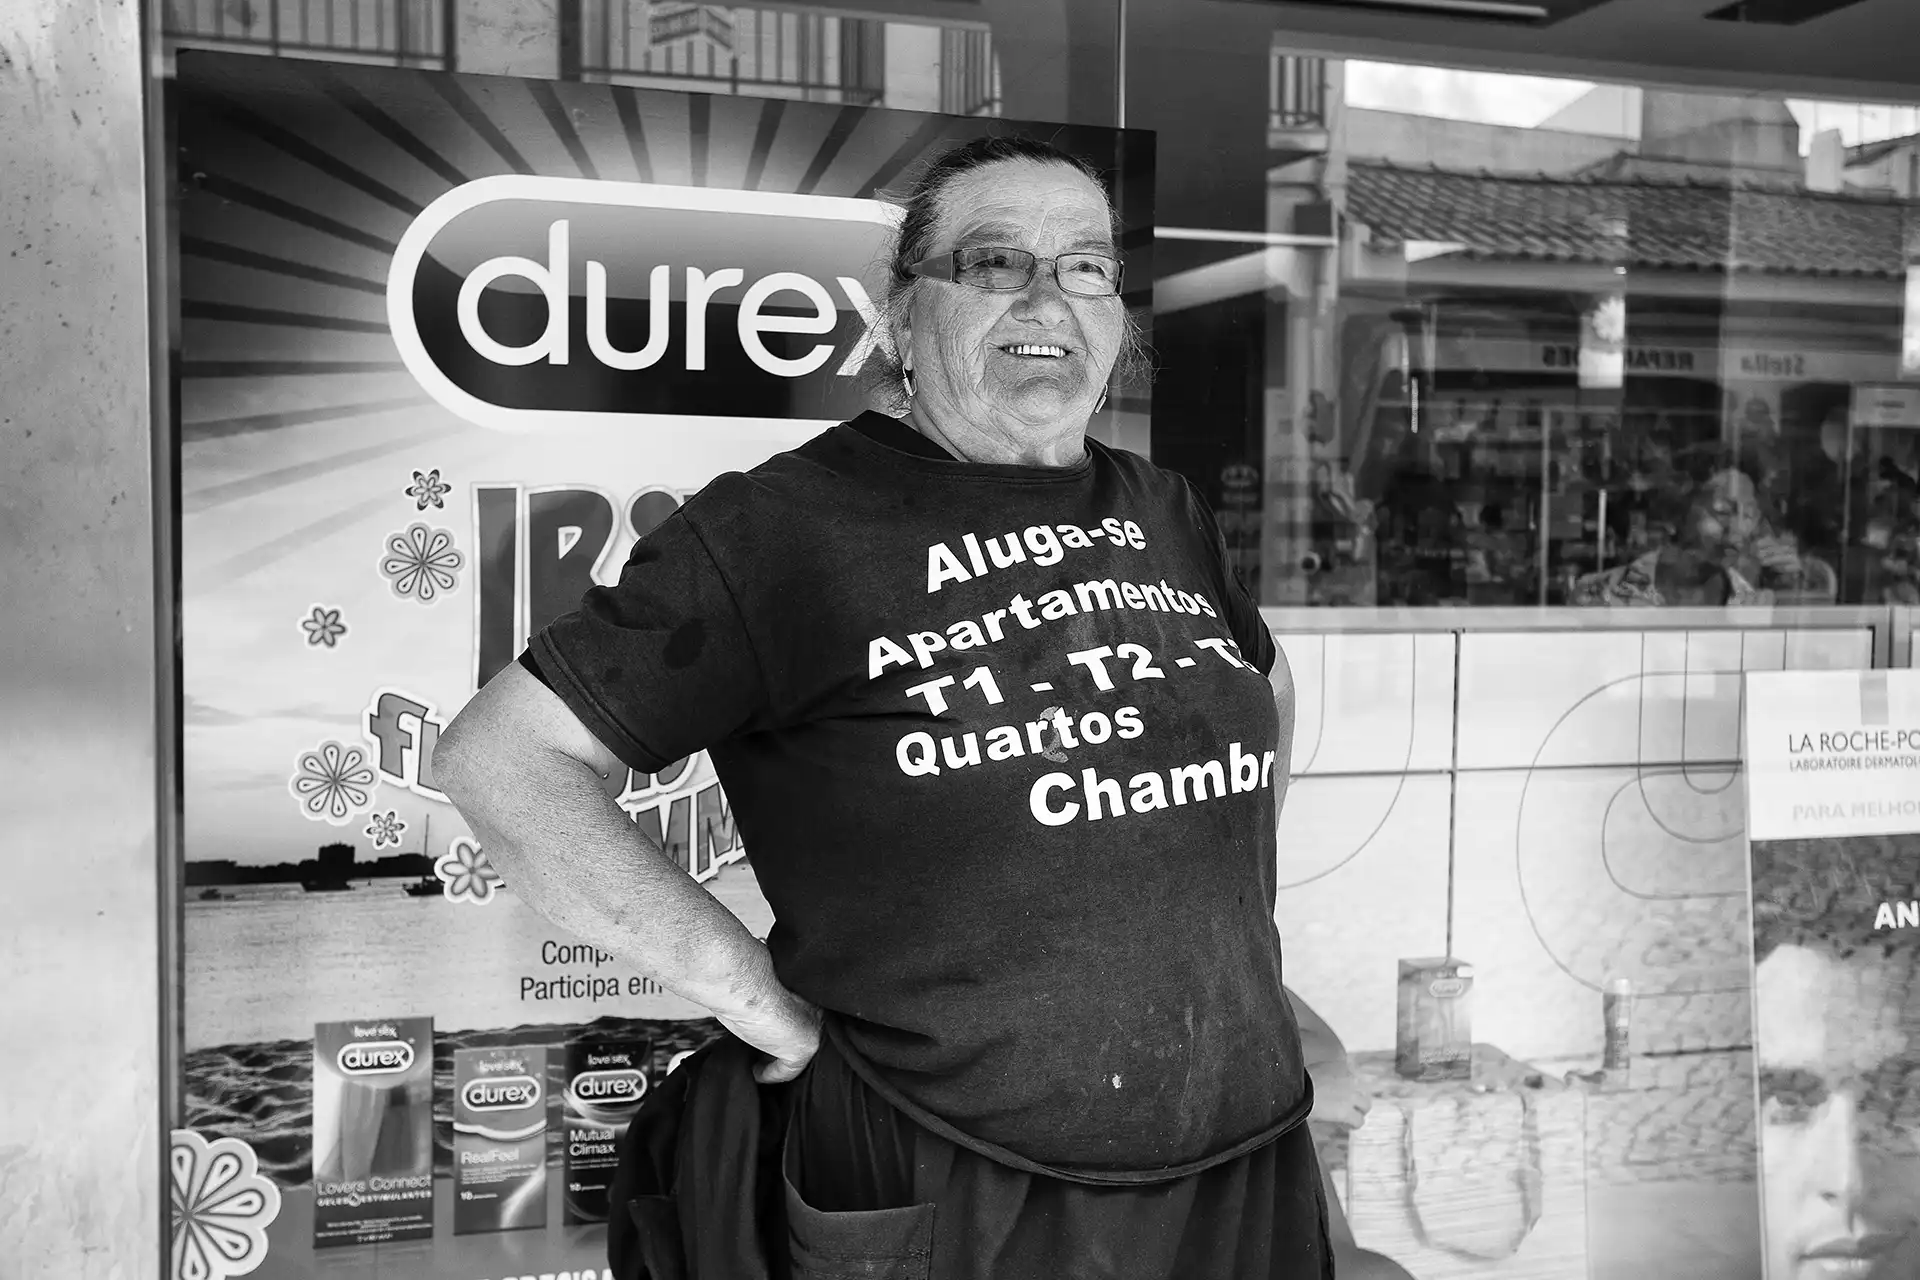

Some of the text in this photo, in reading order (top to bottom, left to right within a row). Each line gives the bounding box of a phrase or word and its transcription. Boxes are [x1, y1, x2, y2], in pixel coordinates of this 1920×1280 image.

[457, 218, 898, 377] durex
[927, 517, 1147, 594] Aluga-se
[868, 578, 1217, 680] Apartamentos
[905, 665, 1005, 717] T1
[1066, 642, 1166, 692] T2
[895, 706, 1145, 777] Quartos
[1788, 733, 1814, 753] LA
[1789, 755, 1920, 772] LABORATOIRE DERMATOL
[1029, 741, 1275, 826] Chambr
[1792, 799, 1920, 821] PARA MELHO
[1874, 900, 1920, 930] AN
[520, 974, 620, 1002] Participa
[345, 1049, 408, 1068] durex
[470, 1085, 533, 1104] durex
[579, 1077, 641, 1096] durex
[570, 1128, 615, 1142] Mutual
[317, 1174, 431, 1196] Lovers Connect
